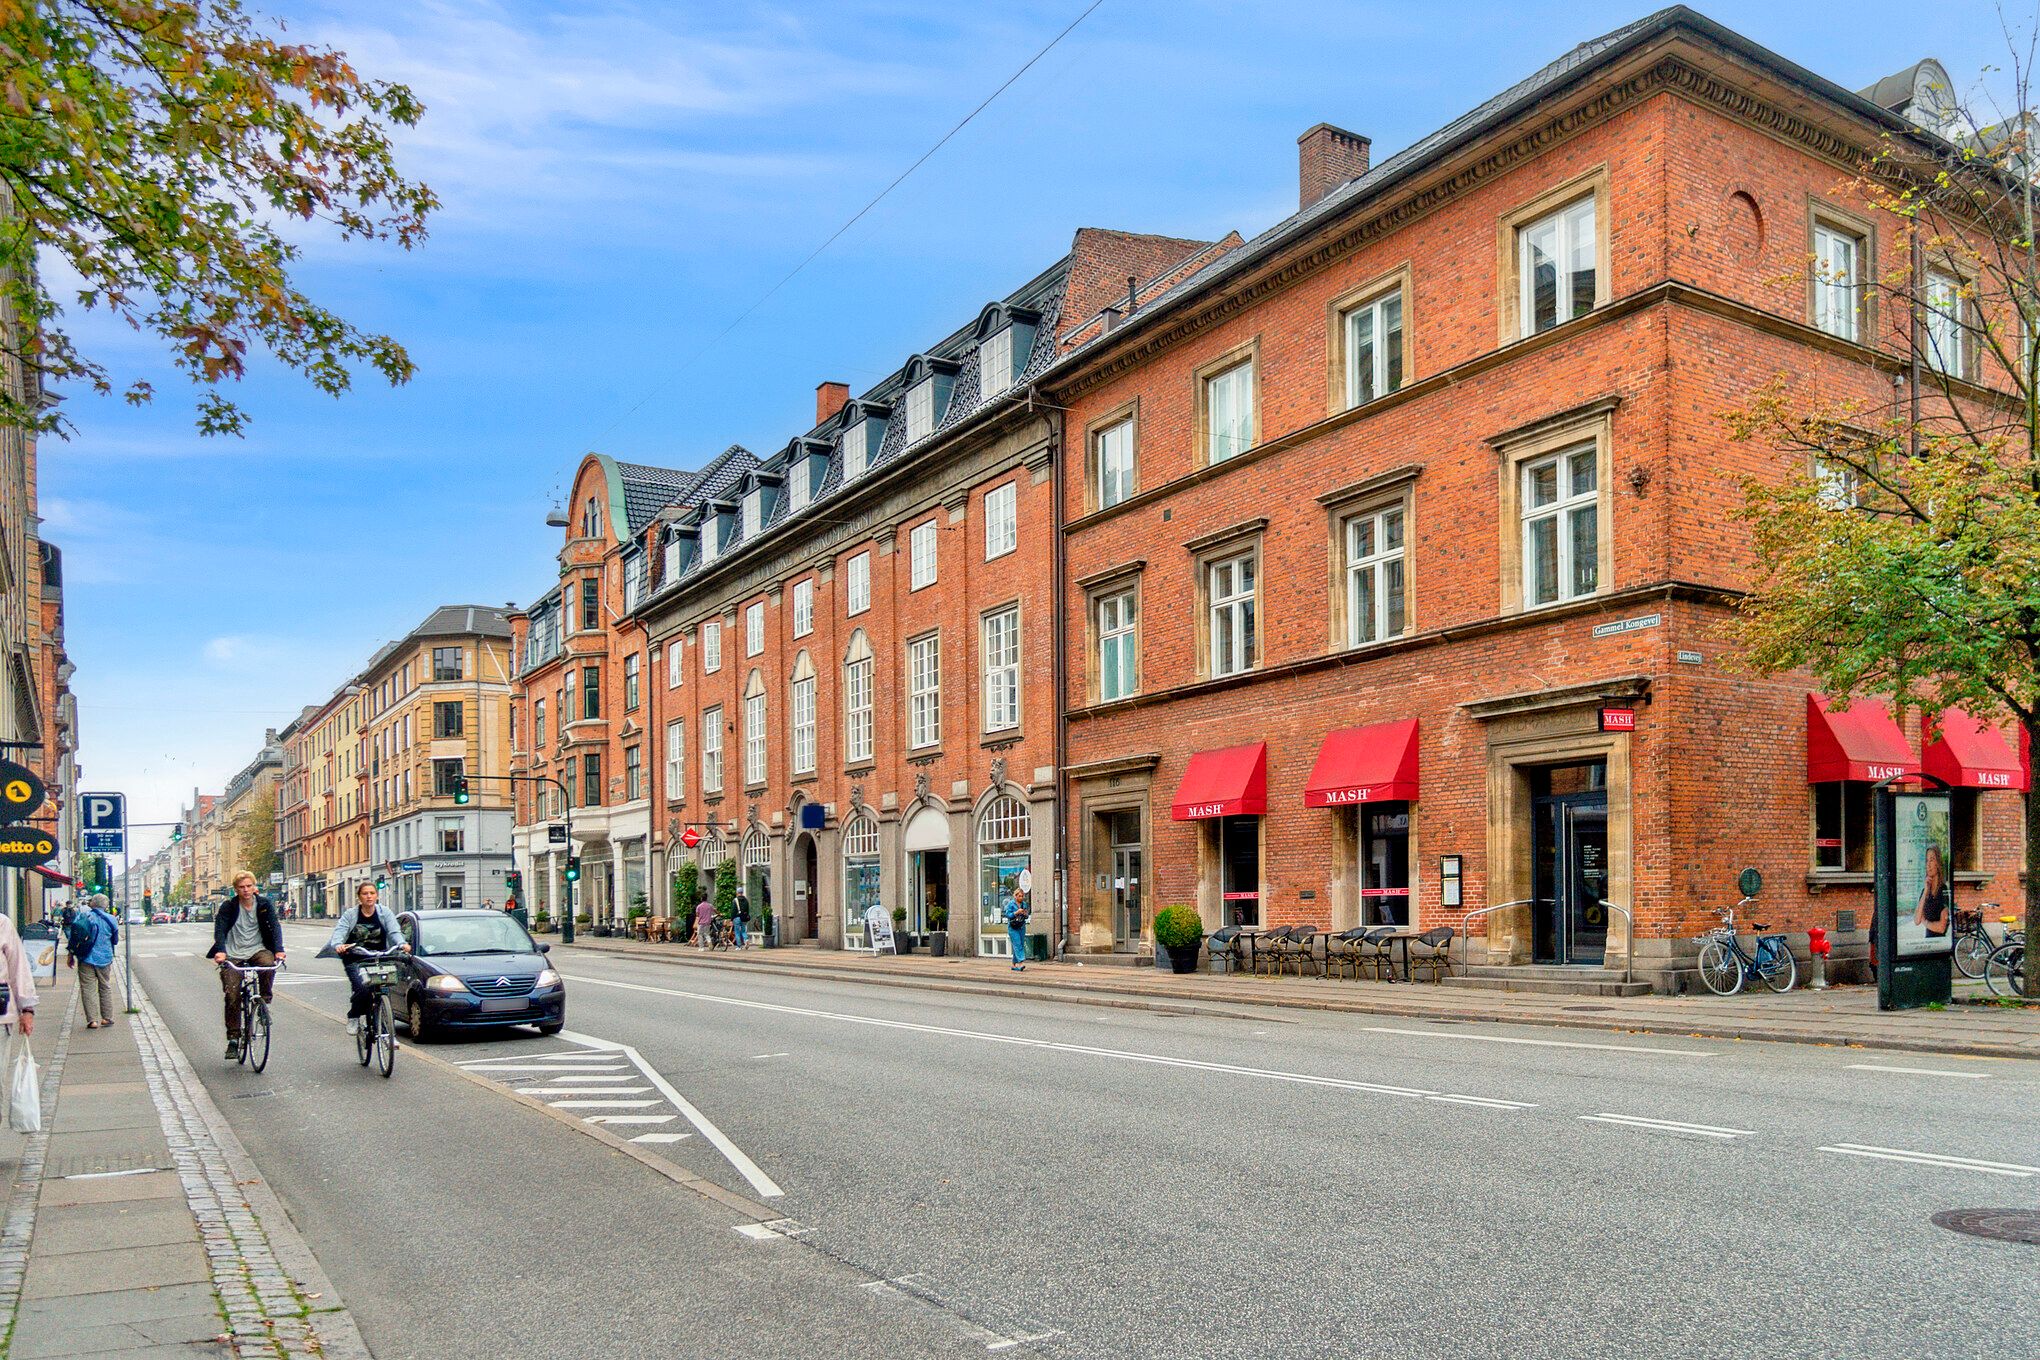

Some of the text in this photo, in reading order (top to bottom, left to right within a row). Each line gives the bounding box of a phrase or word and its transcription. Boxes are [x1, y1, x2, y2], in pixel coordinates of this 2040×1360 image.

[1594, 615, 1658, 635] Gammel Kongevej
[1604, 715, 1632, 724] MASH
[91, 799, 114, 826] P
[0, 841, 34, 853] etto
[434, 861, 465, 869] Nykredit
